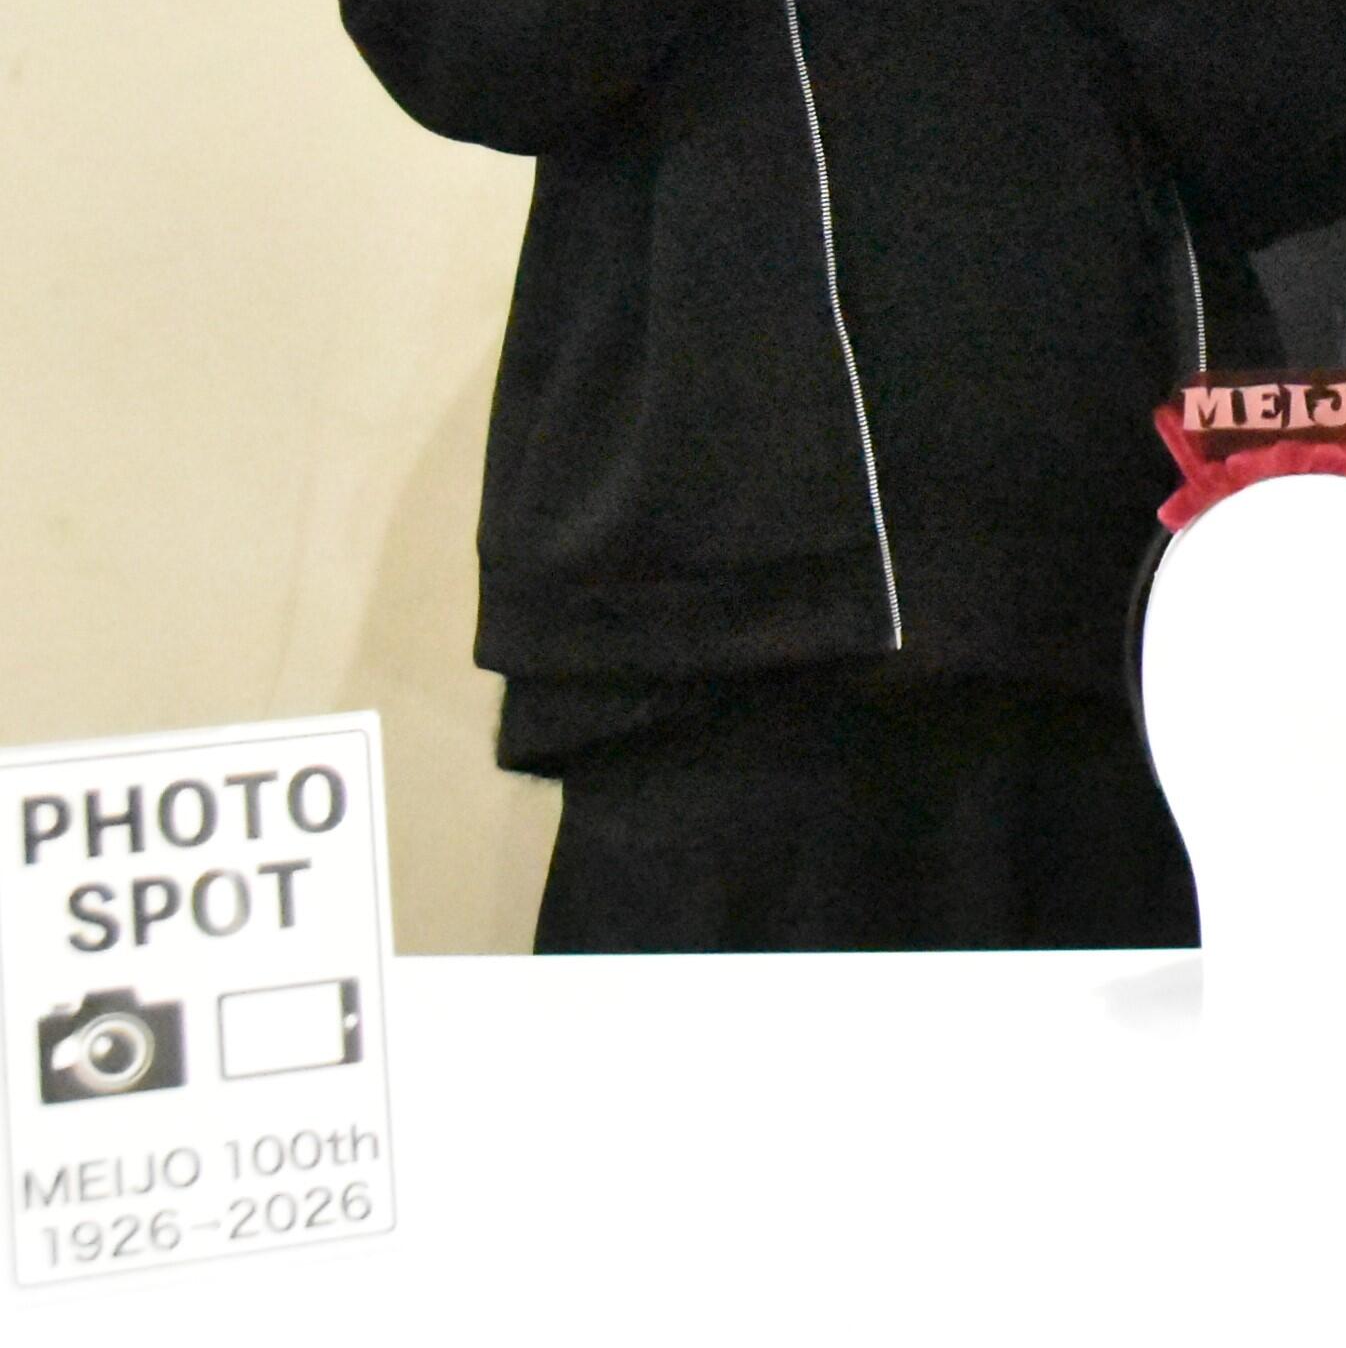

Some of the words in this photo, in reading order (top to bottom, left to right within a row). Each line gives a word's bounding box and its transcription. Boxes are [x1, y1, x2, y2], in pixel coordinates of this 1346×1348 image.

[21, 764, 348, 866] PHOTO
[67, 858, 312, 953] SPOT
[24, 1145, 202, 1212] MEIJO
[225, 1122, 381, 1183] 100th
